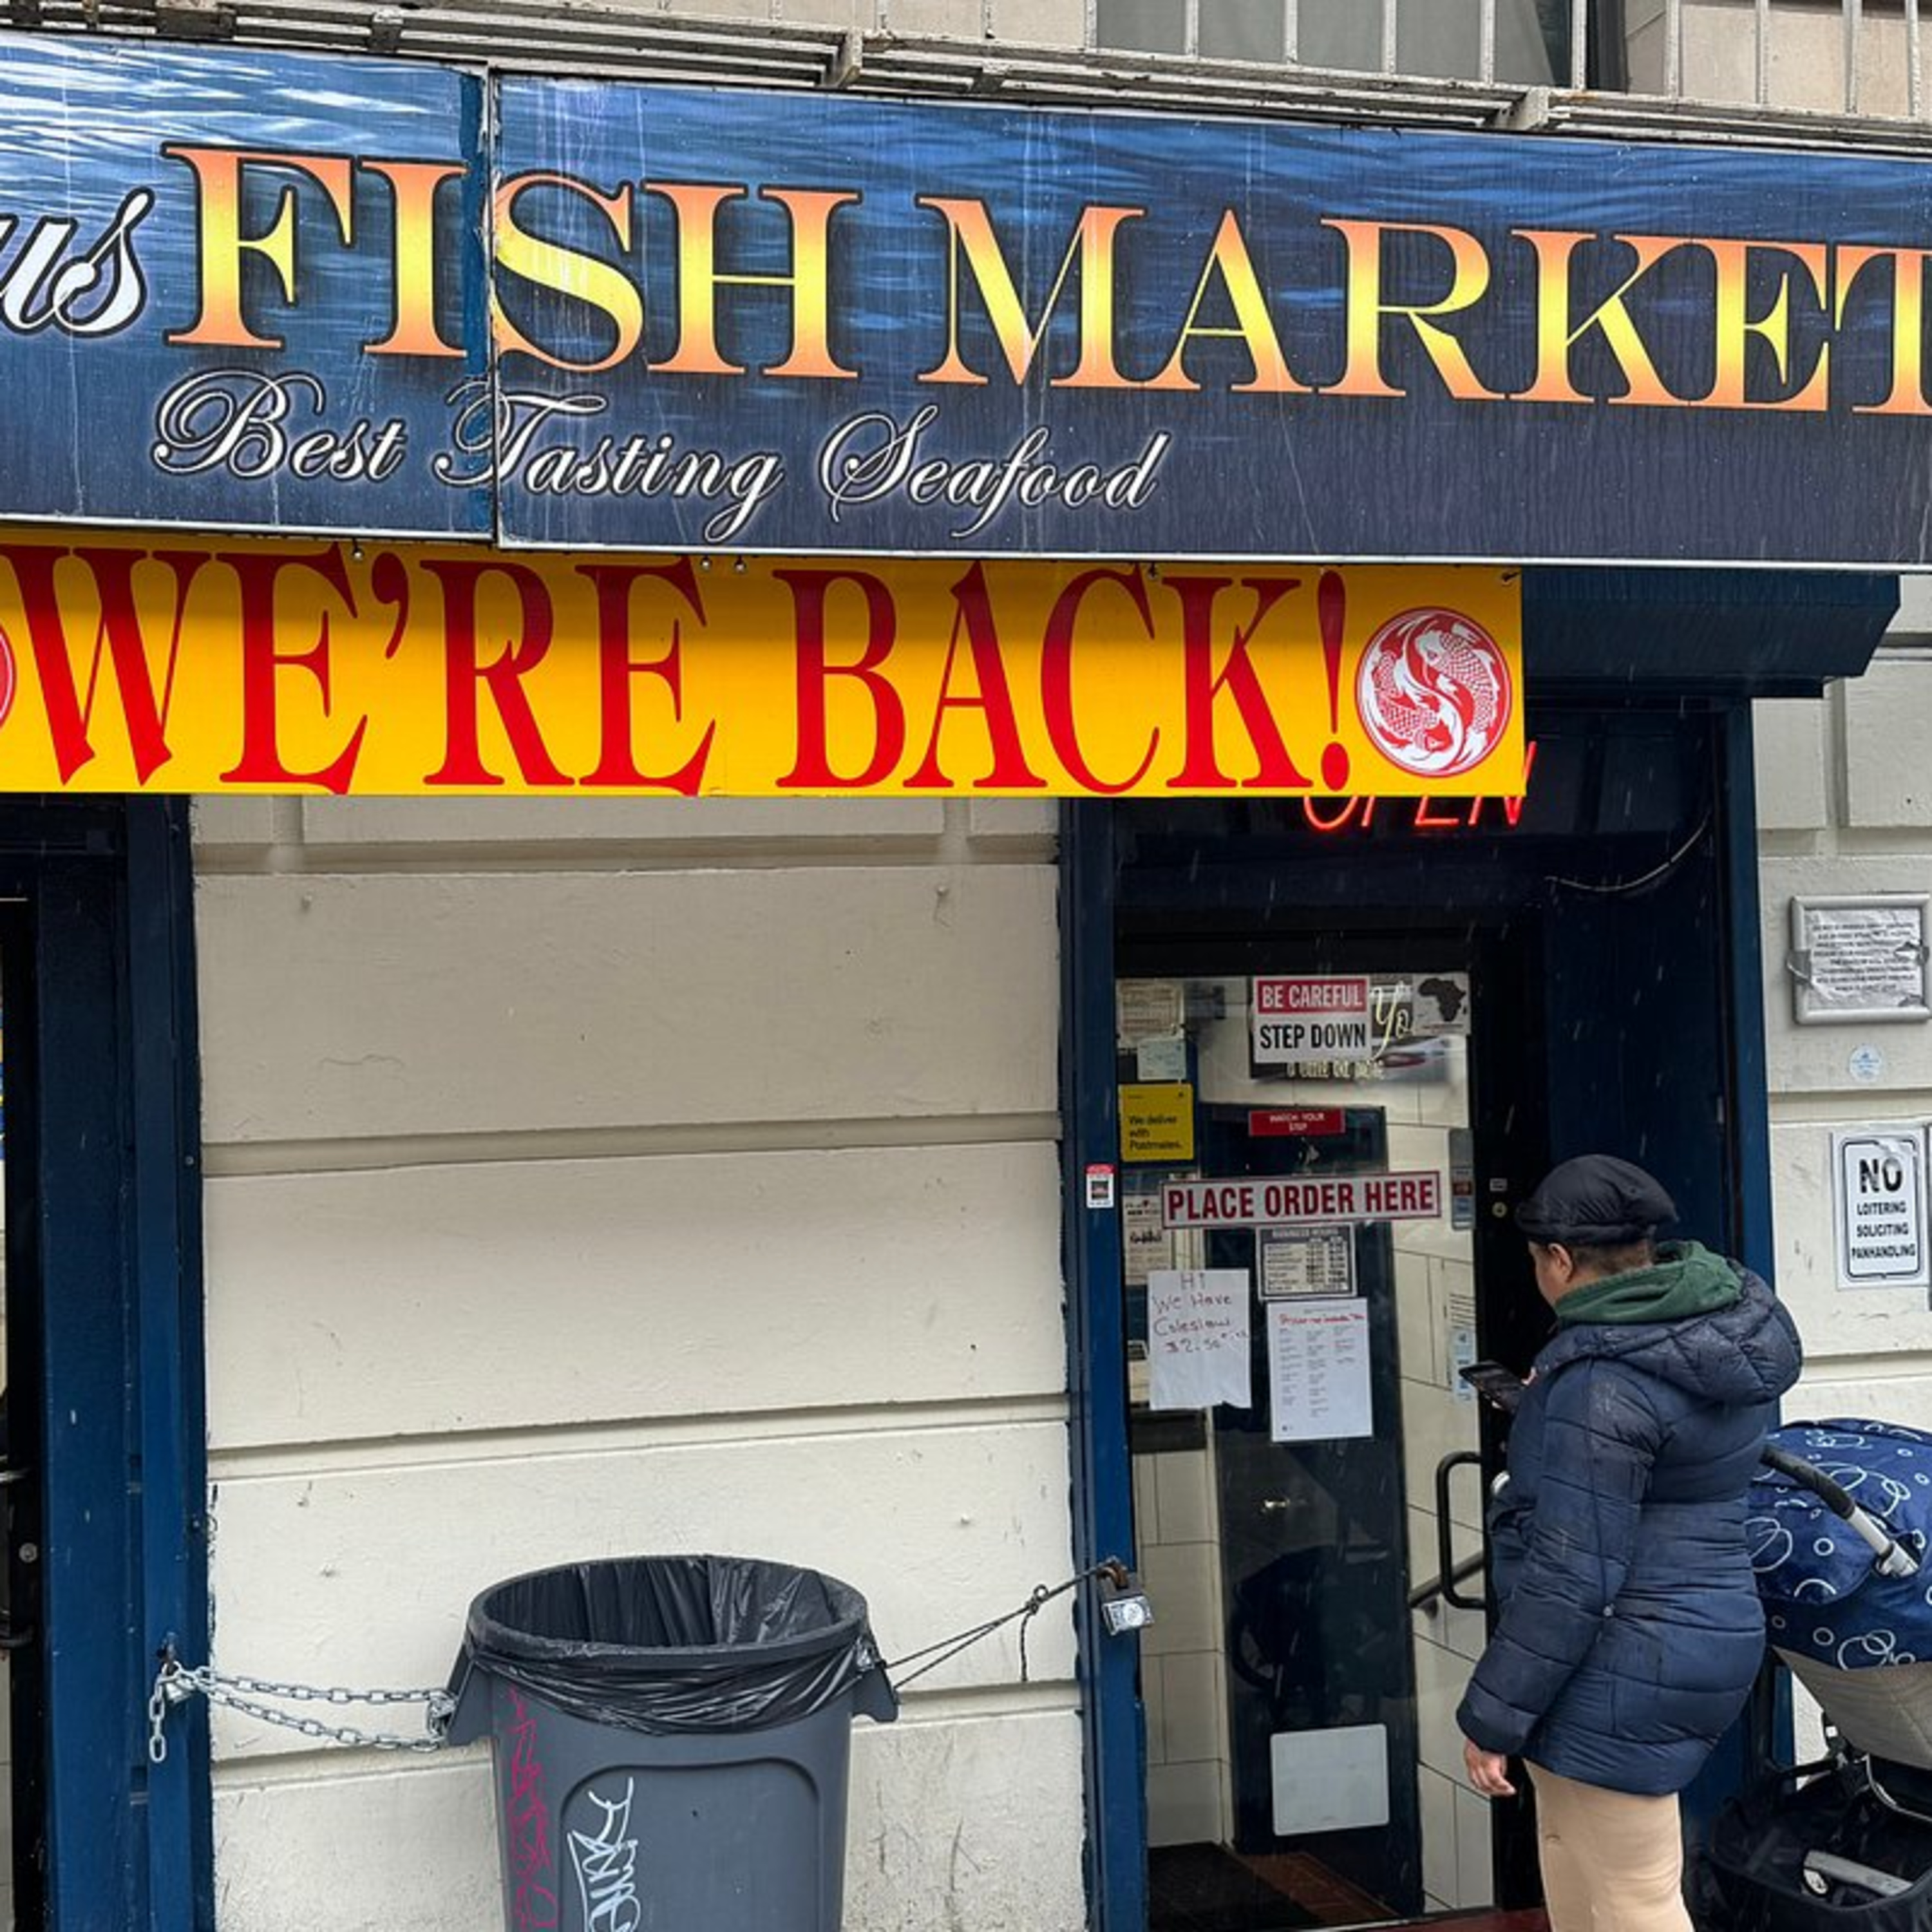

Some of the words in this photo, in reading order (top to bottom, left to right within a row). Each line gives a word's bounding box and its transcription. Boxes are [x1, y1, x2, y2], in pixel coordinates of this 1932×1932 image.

[164, 144, 860, 378] FISH
[917, 196, 1932, 416] MARKET
[156, 372, 404, 478] Best
[437, 381, 783, 544] Tasting
[820, 404, 1170, 538] Seafood
[0, 541, 715, 795] WE'RE
[773, 560, 1350, 794] BACK!
[1262, 985, 1283, 1009] BE
[1288, 983, 1364, 1009] CAREFUL
[1260, 1024, 1305, 1049] STEP
[1311, 1023, 1366, 1048] DOWN
[1146, 1115, 1177, 1124] deliver
[1859, 1158, 1903, 1193] NO
[1168, 1188, 1254, 1220] PLACE
[1265, 1182, 1354, 1217] ORDER
[1364, 1180, 1434, 1213] HERE
[1857, 1201, 1907, 1216] LOITERING
[1857, 1222, 1909, 1238] SOLICITING
[1852, 1244, 1916, 1260] PANHANDLING
